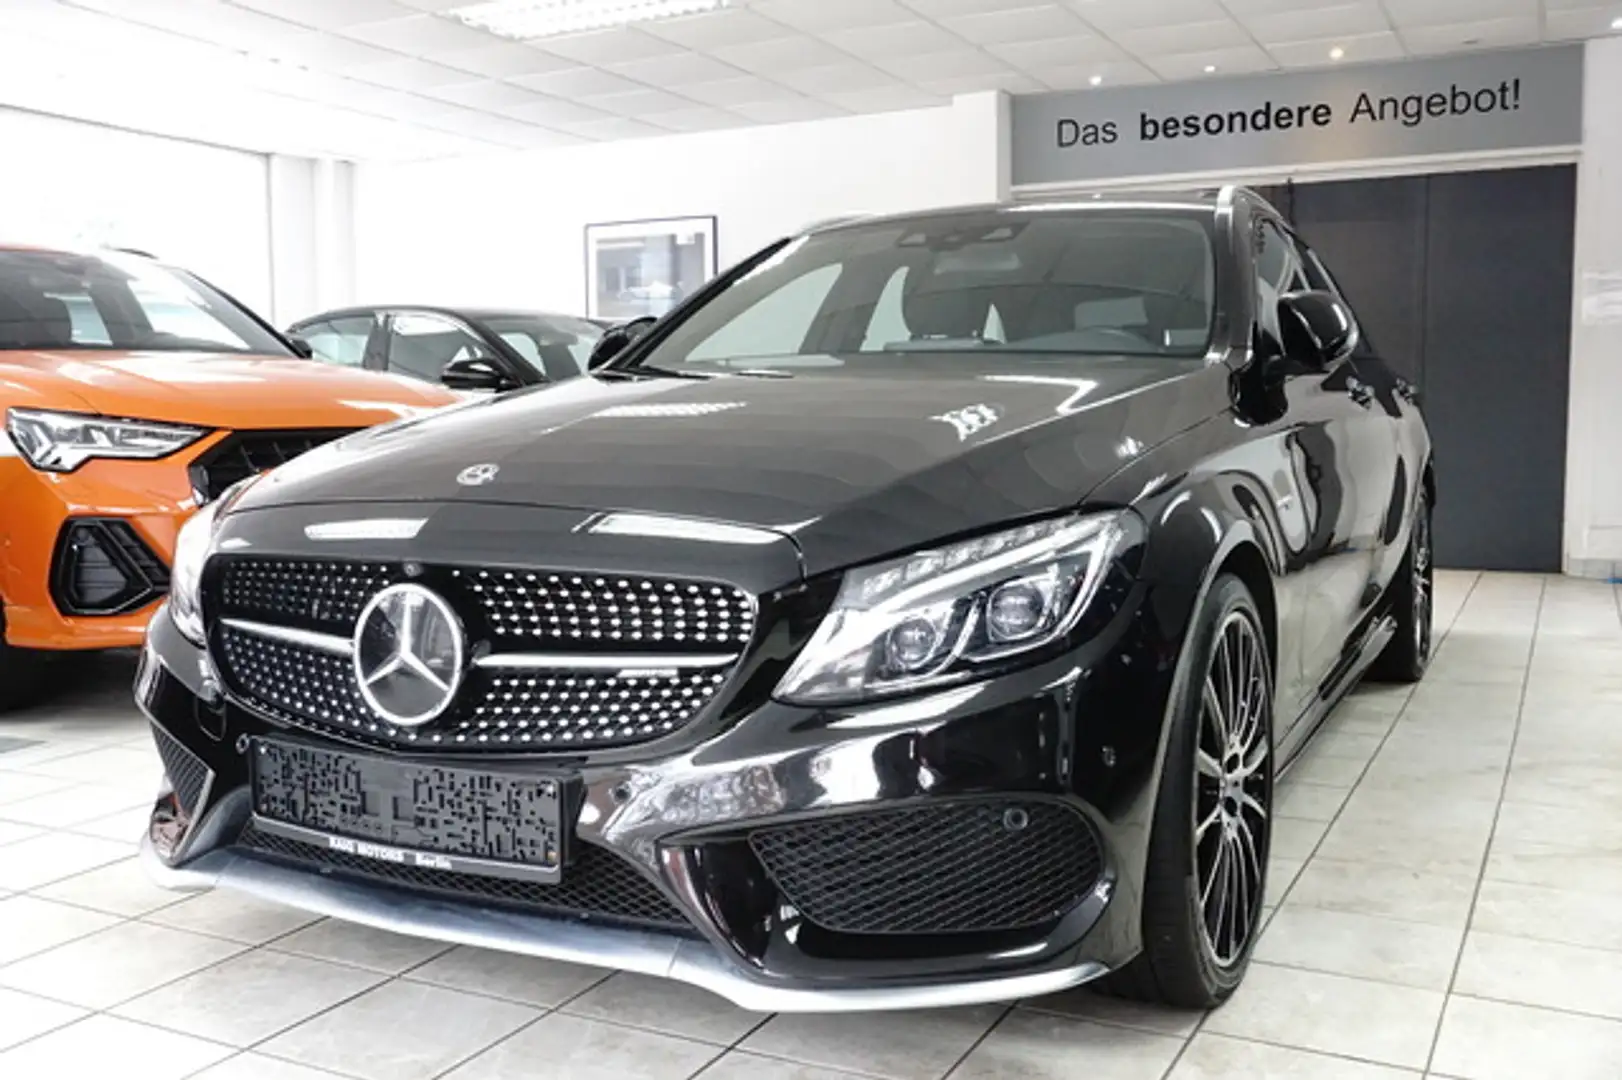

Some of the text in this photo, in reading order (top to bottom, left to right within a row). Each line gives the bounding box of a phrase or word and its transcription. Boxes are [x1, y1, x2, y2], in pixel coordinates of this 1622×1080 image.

[1057, 77, 1520, 148] Das besondere Angebot!
